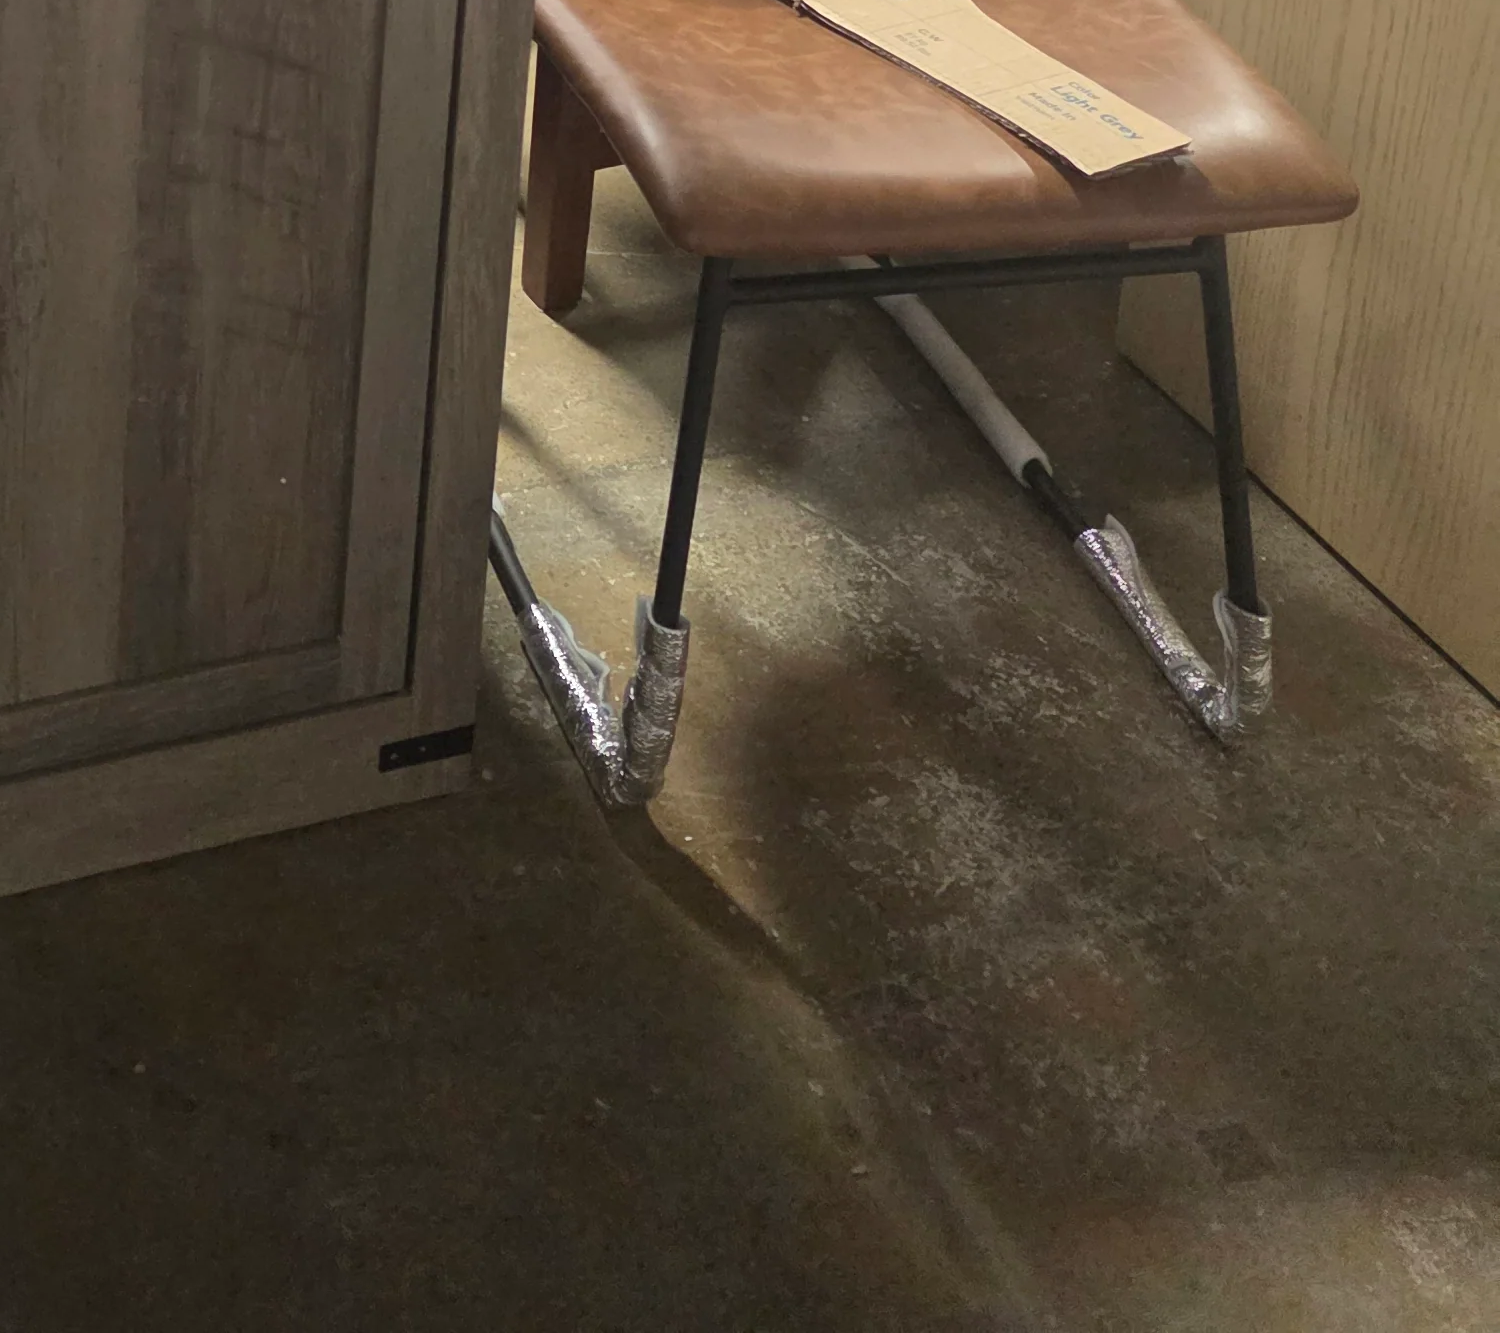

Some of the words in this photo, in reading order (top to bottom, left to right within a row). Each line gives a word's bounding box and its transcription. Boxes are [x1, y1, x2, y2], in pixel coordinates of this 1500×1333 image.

[1028, 92, 1062, 112] Made
[1051, 86, 1098, 113] Light
[1100, 114, 1144, 139] Grey
